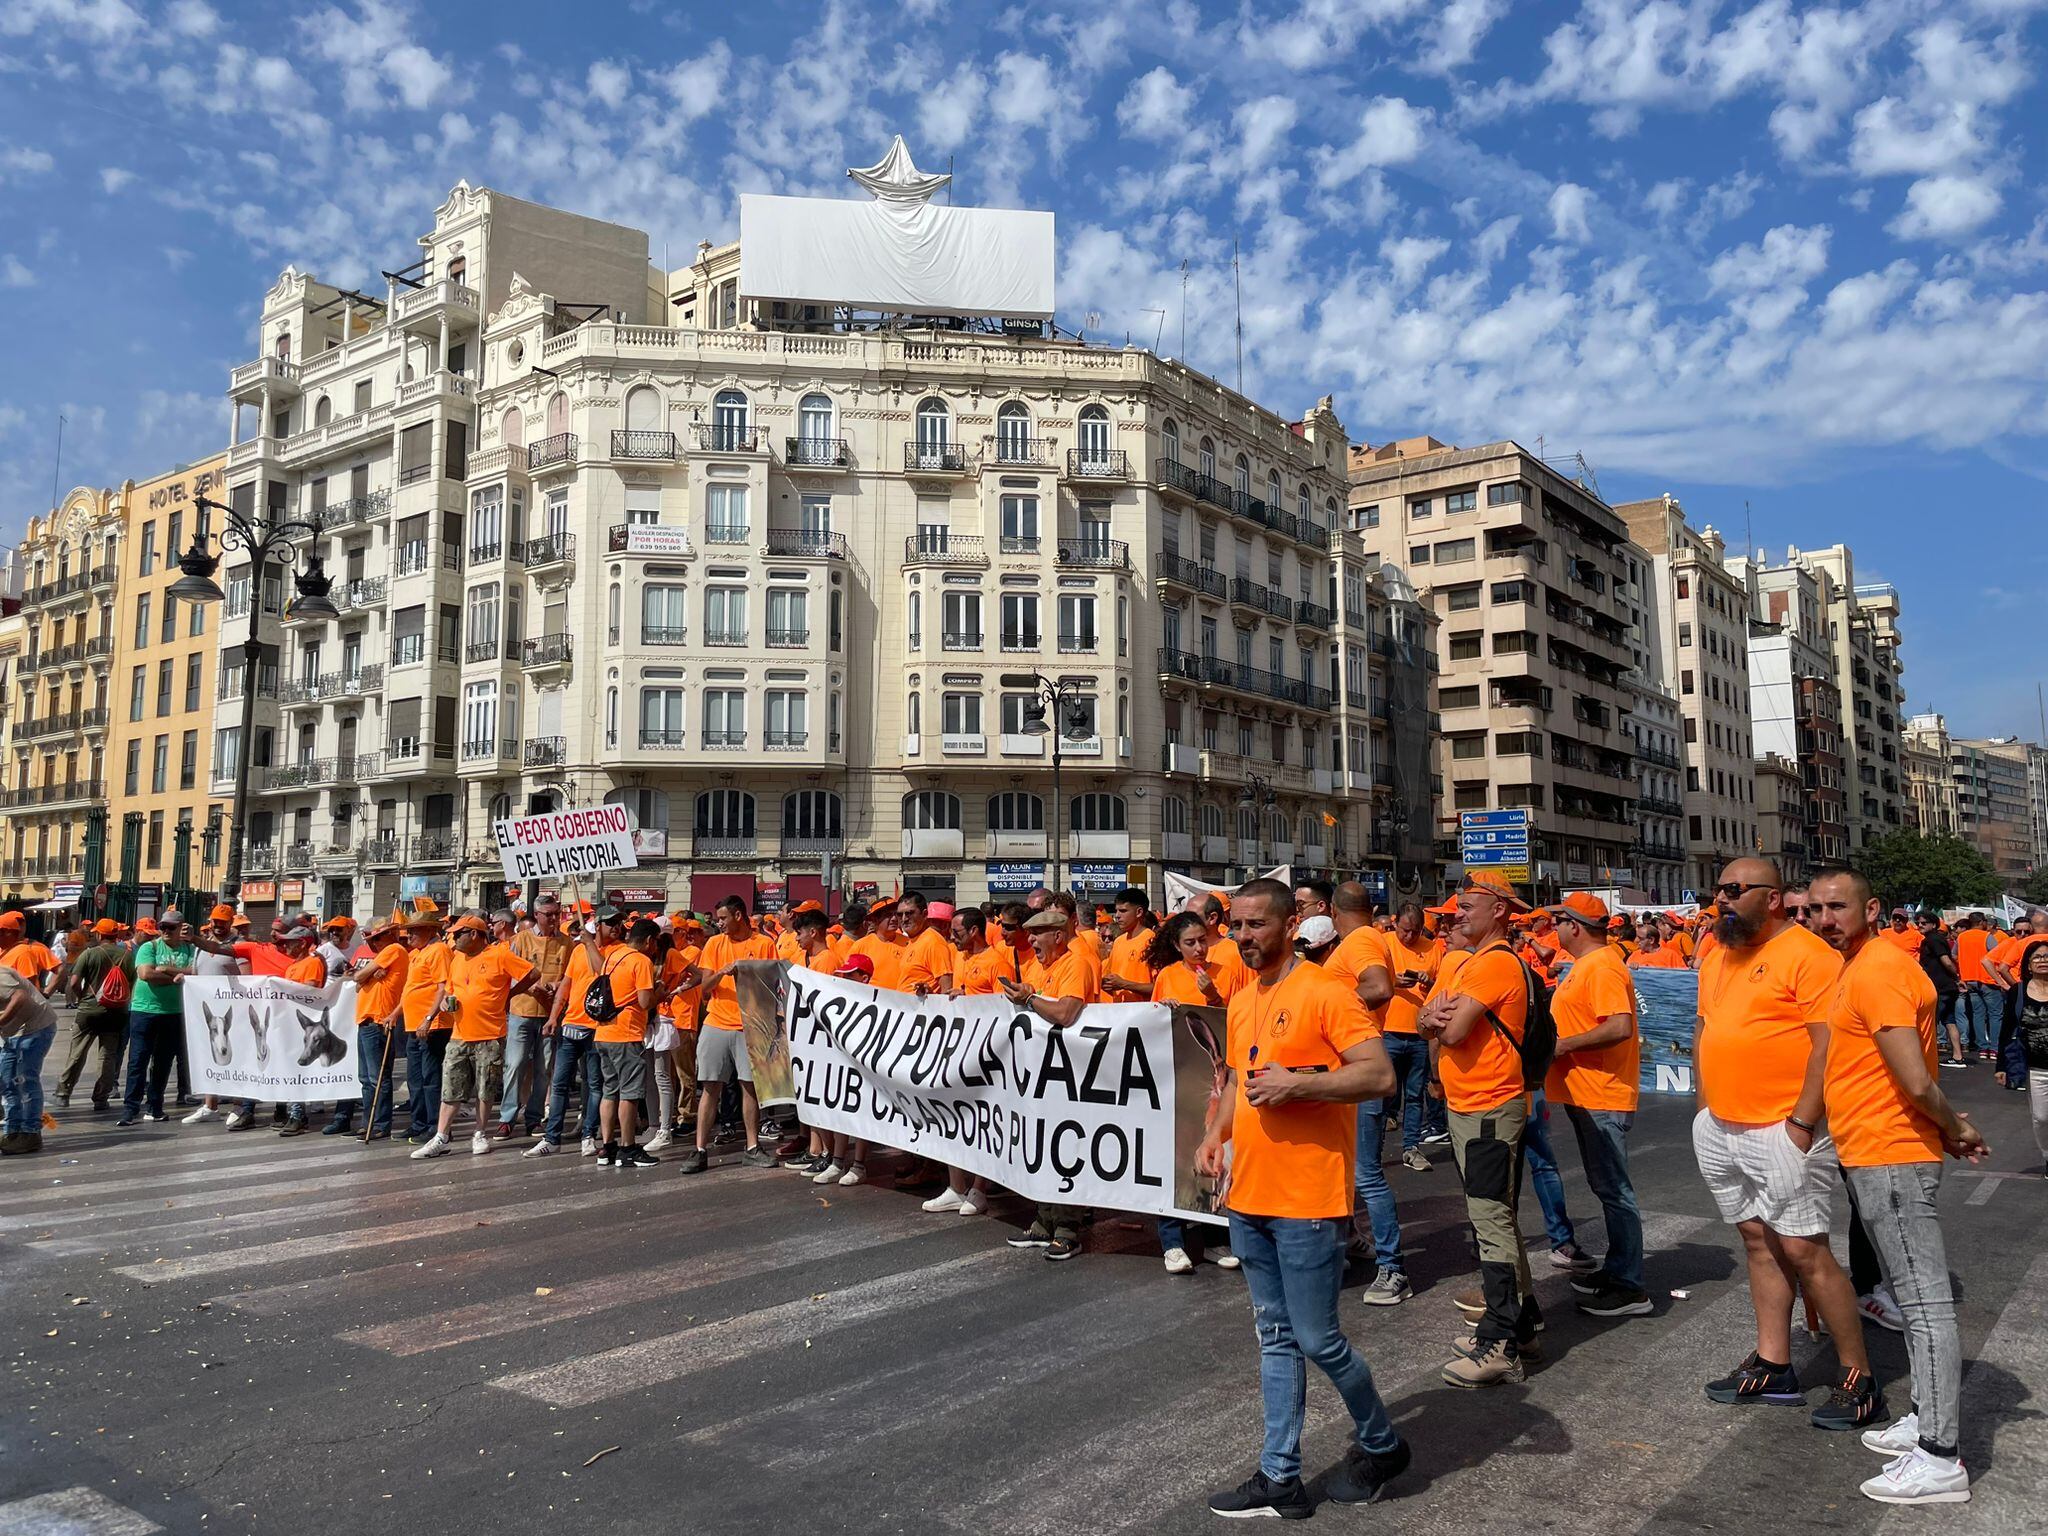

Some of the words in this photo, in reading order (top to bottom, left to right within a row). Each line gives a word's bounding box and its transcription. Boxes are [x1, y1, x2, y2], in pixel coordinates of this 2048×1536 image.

[1004, 319, 1040, 329] GINSA
[149, 481, 188, 511] HOTEL
[496, 824, 515, 848] EL
[514, 818, 554, 846] PEOR
[554, 807, 626, 840] GOBIERNO
[516, 853, 537, 878] DE
[536, 850, 557, 875] LA
[556, 841, 622, 872] HISTORIA
[215, 987, 244, 999] Amics
[246, 987, 262, 999] del
[789, 981, 905, 1074] PASIÓN
[888, 1014, 966, 1088] POR
[958, 1016, 1007, 1090] LA
[1008, 1013, 1162, 1111] CAZA
[206, 1068, 231, 1083] Orgull
[232, 1070, 248, 1081] dels
[283, 1072, 353, 1085] valencians
[791, 1057, 863, 1113] CLUB
[1008, 1110, 1163, 1194] PUÇOL
